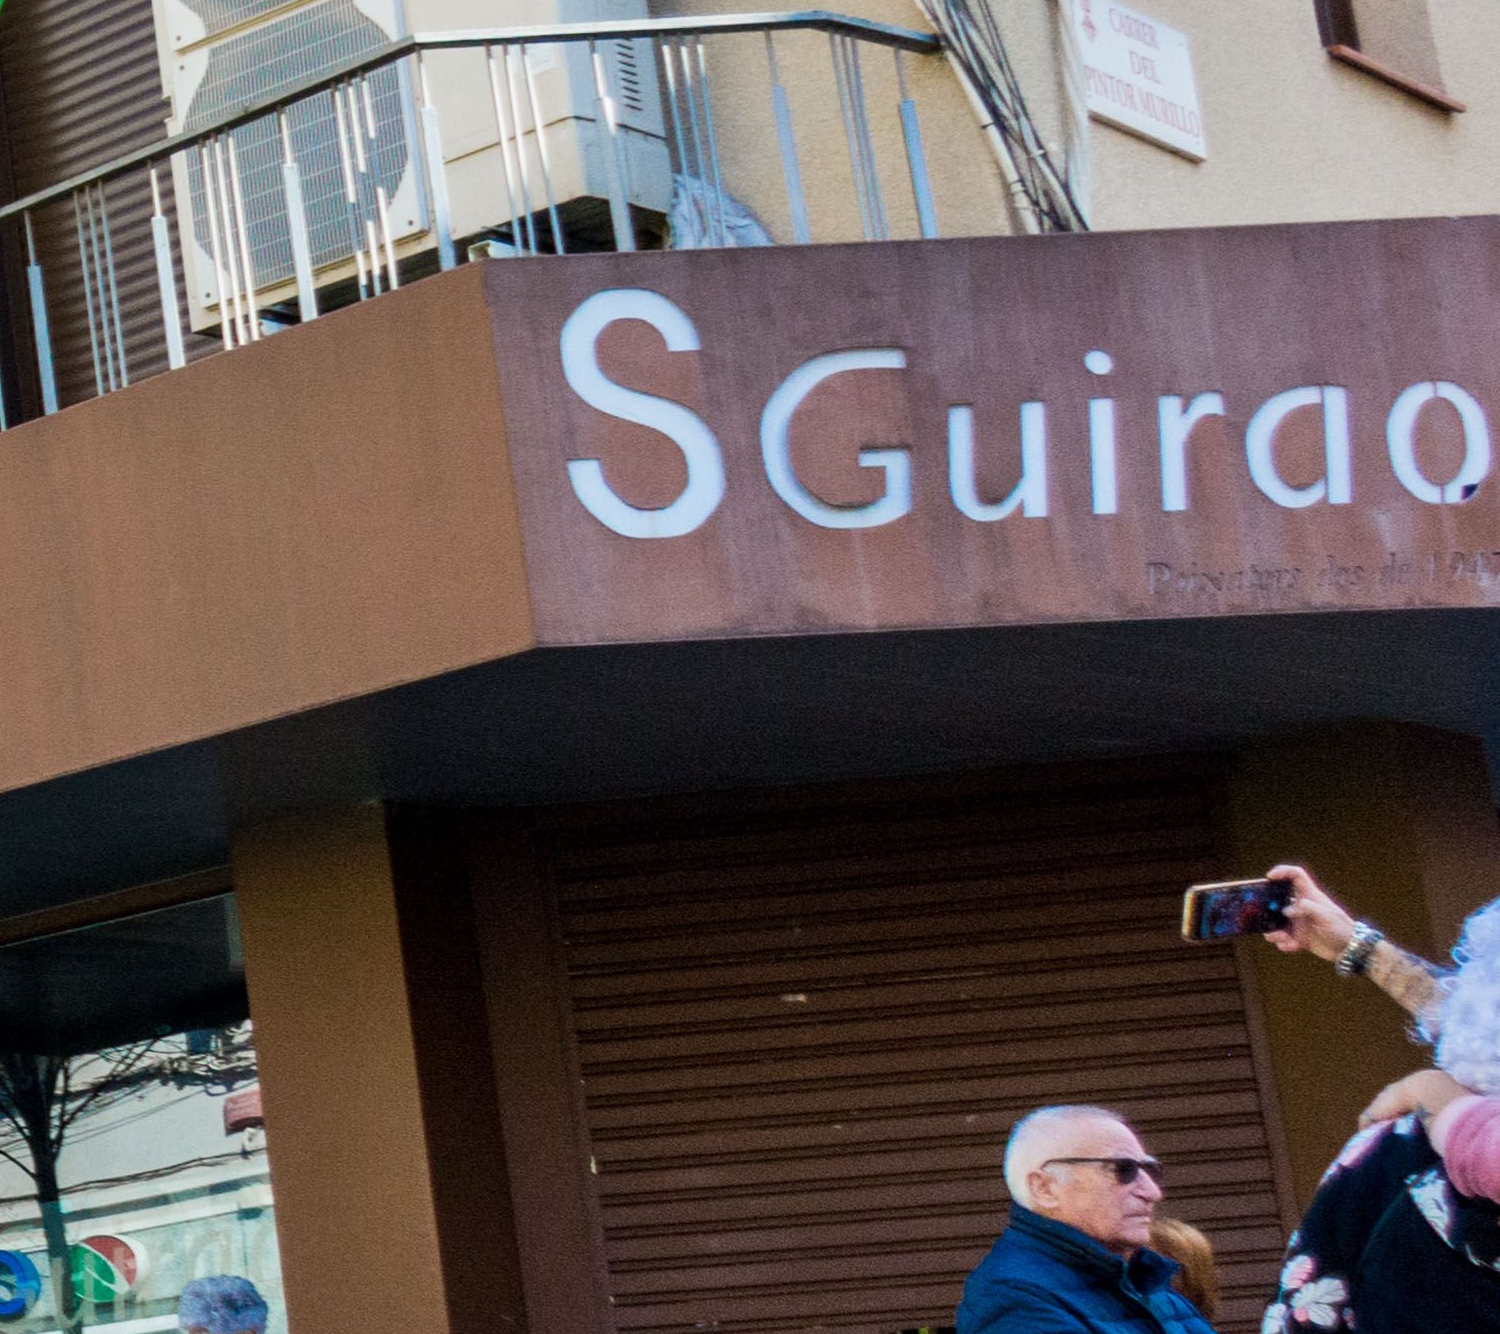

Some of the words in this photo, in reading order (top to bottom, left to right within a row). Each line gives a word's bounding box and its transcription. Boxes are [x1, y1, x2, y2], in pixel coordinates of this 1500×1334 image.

[1108, 7, 1159, 50] CARRER
[1130, 51, 1162, 84] DEL
[1083, 65, 1139, 112] PINTOR
[1138, 88, 1200, 138] MURILLO
[559, 287, 726, 539] S
[759, 347, 1492, 531] Guirao
[1431, 550, 1500, 587] 194
